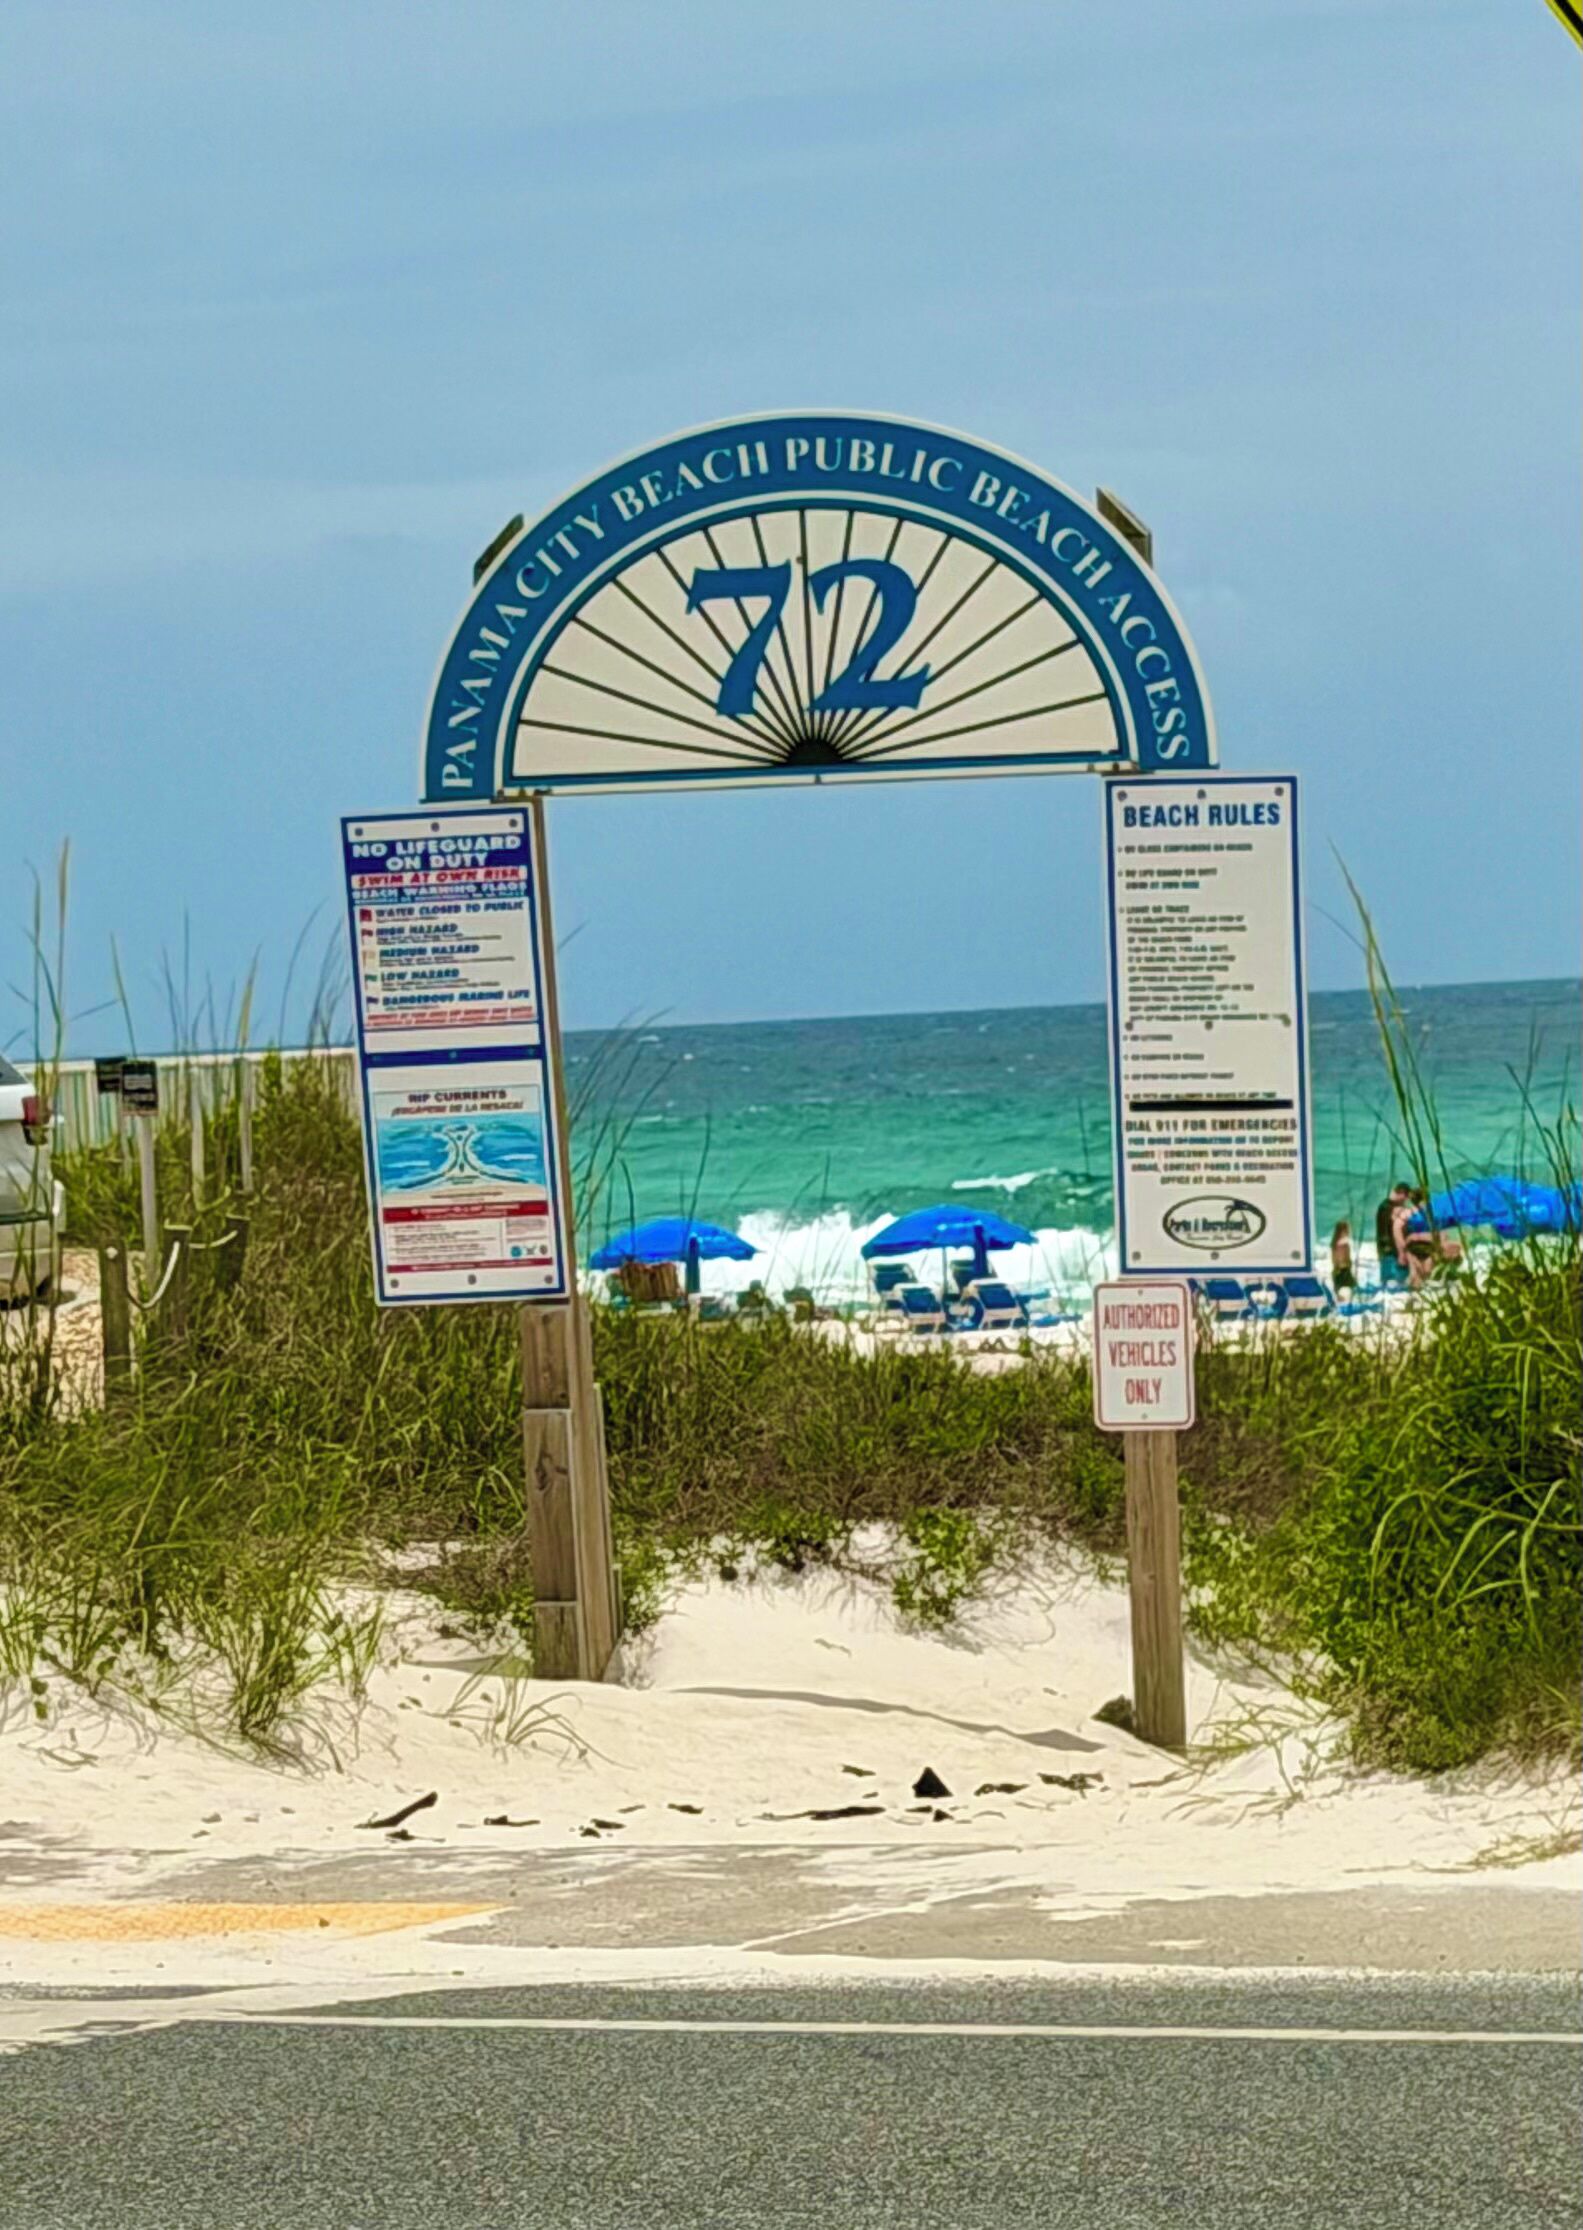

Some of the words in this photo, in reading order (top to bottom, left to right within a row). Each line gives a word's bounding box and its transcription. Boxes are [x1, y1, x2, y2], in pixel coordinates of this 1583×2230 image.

[442, 604, 528, 788] PANAMA
[516, 504, 605, 598] CITY
[611, 441, 768, 522] BEACH
[785, 437, 963, 491] PUBLIC
[969, 470, 1112, 589] BEACH
[1099, 593, 1190, 759] ACCESS
[685, 559, 932, 716] 72
[1124, 804, 1199, 827] BEACH
[1208, 803, 1280, 826] RULES
[352, 843, 388, 857] NO
[395, 835, 521, 855] LIFEGUARD
[386, 856, 421, 871] ON
[429, 852, 488, 868] DUTY
[358, 875, 404, 887] SWIM
[410, 873, 429, 884] AT
[436, 871, 478, 882] OWN
[484, 868, 520, 881] RISK
[434, 1089, 507, 1102] CURRENTS
[1125, 1120, 1151, 1132] DIAL
[1156, 1119, 1178, 1131] 911
[1183, 1119, 1207, 1131] FOR
[1211, 1118, 1297, 1131] EMERGENCIES
[1103, 1303, 1180, 1330] AUTHORIZED
[1108, 1340, 1177, 1368] VEHICLES
[1124, 1377, 1162, 1406] ONLY
